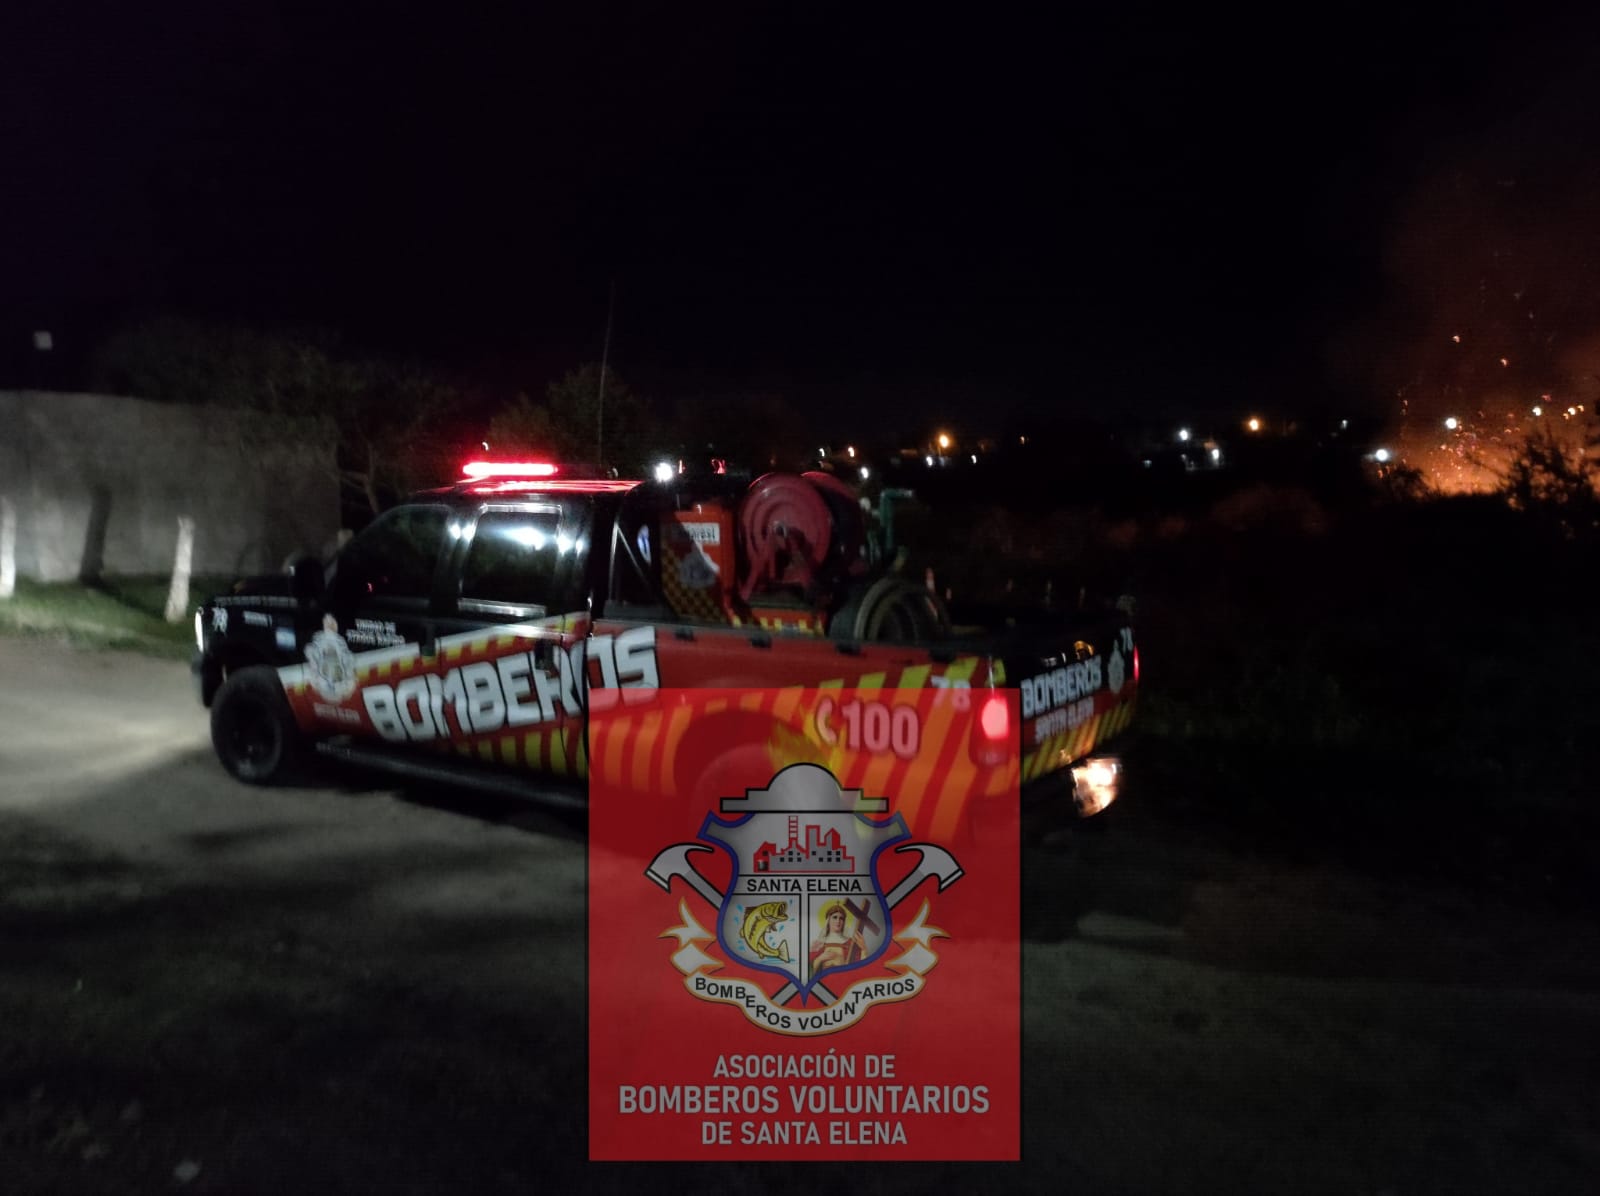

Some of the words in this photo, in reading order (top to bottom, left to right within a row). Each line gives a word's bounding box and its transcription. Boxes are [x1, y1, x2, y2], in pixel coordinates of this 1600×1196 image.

[362, 626, 660, 742] BOMBEROS
[1021, 655, 1102, 719] BOMBEROS
[842, 699, 919, 758] 100
